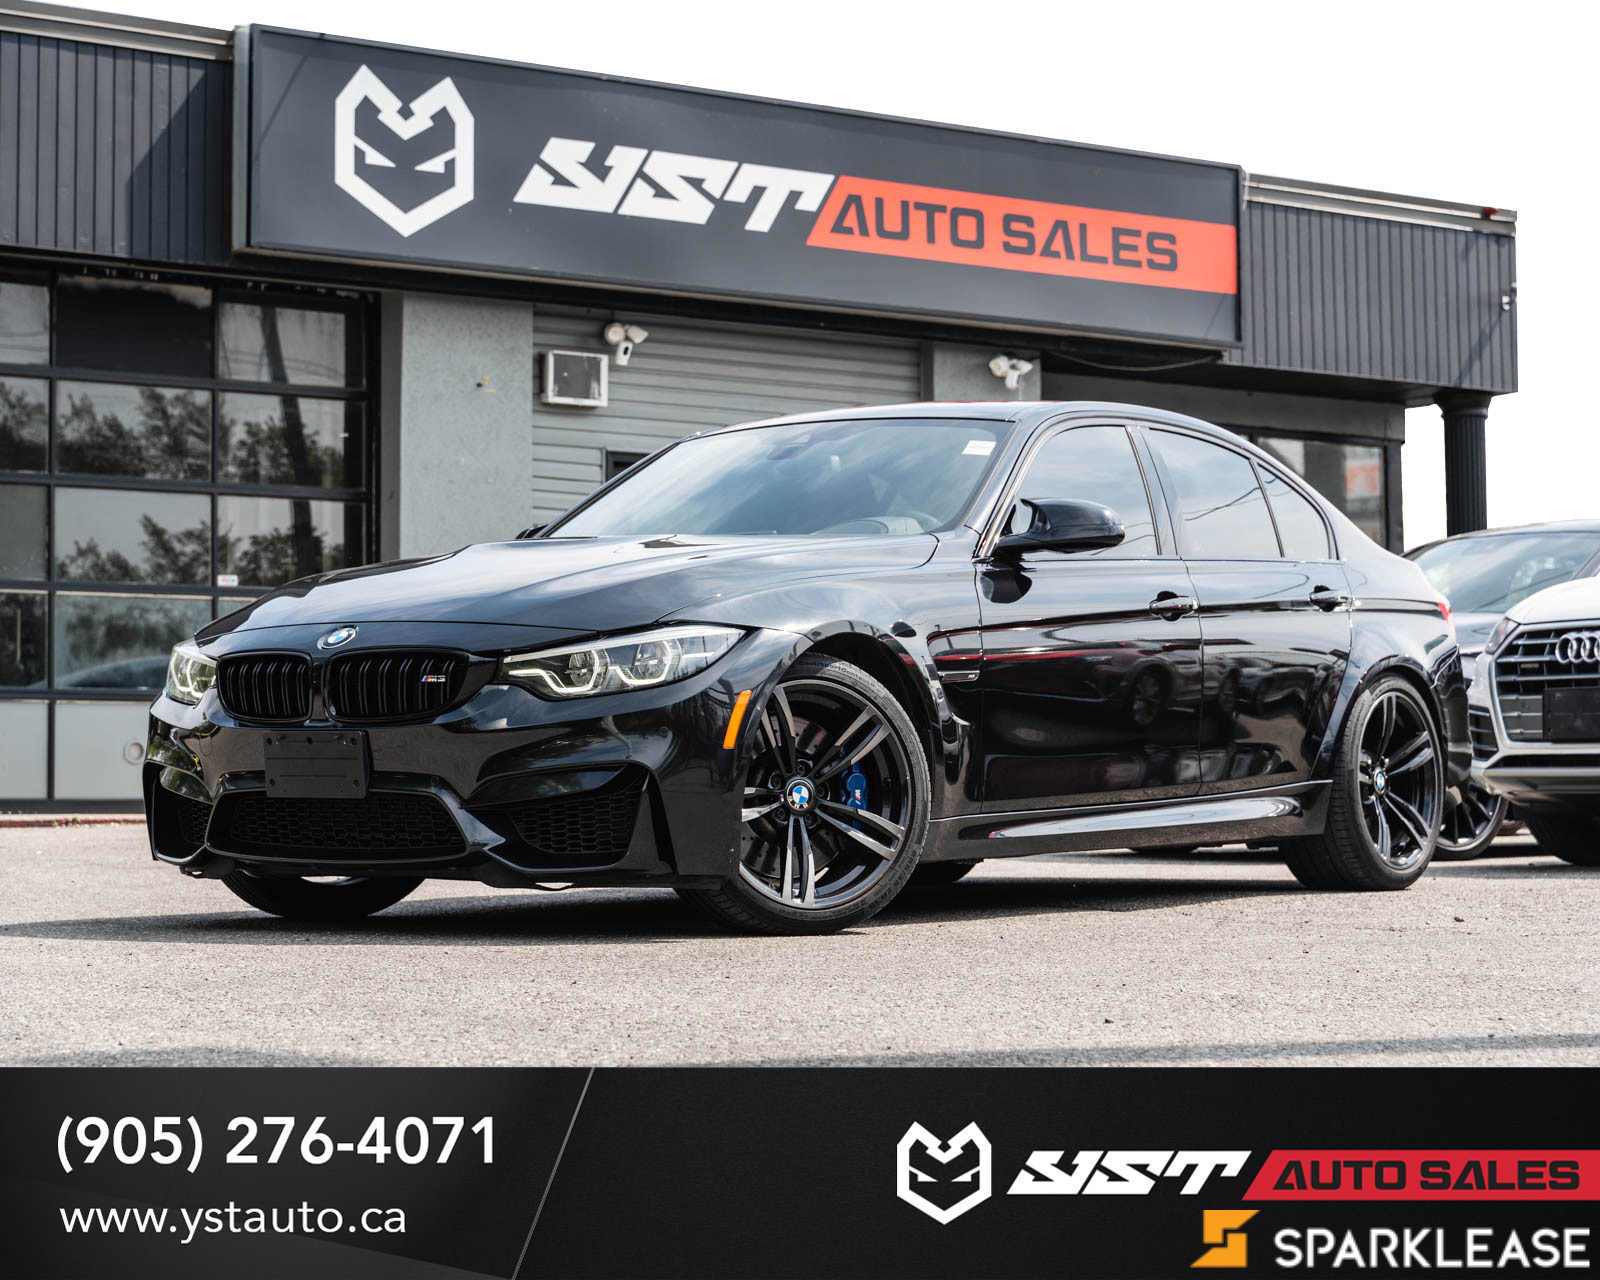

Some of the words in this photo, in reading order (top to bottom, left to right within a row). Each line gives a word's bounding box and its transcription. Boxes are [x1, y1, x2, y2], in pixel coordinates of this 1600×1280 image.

[512, 136, 836, 233] YST
[832, 194, 985, 249] AUTO
[1002, 213, 1178, 272] SALES
